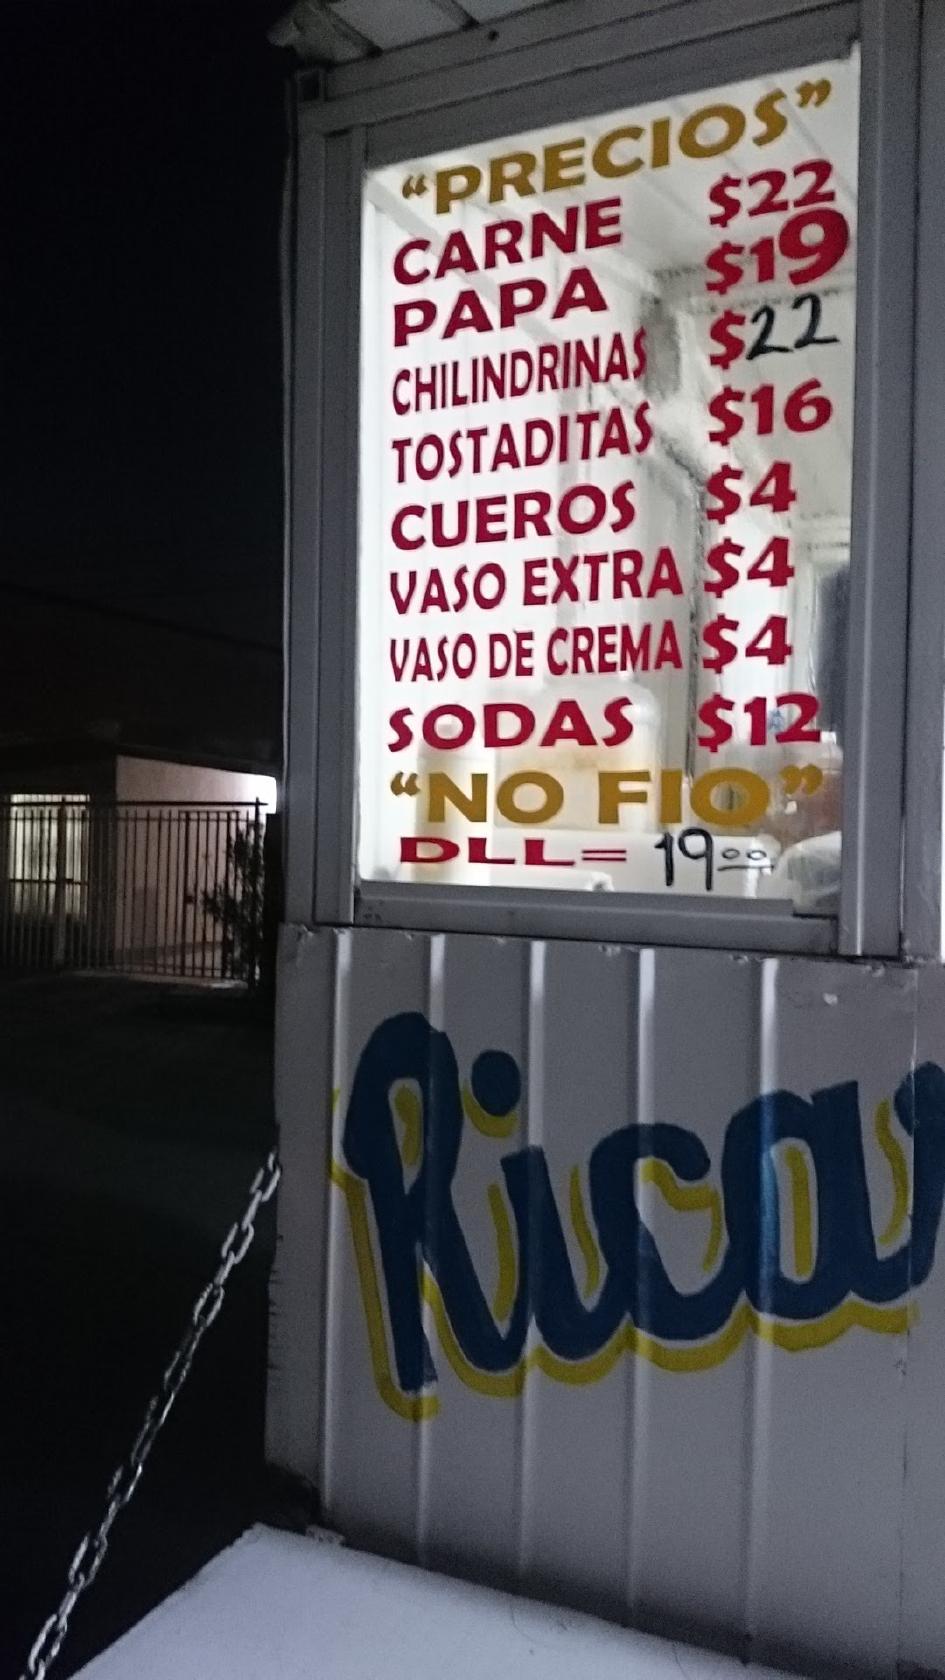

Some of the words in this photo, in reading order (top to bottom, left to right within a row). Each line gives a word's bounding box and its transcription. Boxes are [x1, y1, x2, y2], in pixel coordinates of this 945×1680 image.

[393, 198, 622, 286] CARNE
[709, 159, 835, 228] $22
[394, 267, 608, 347] PAPA
[705, 207, 849, 295] $19
[392, 327, 647, 416] CHILINDRINAS
[709, 293, 839, 370] $22
[391, 401, 653, 484] TOSTADITAS
[708, 378, 833, 446] $16
[391, 481, 635, 551] CUEROS
[705, 461, 797, 525] $4
[390, 561, 506, 615] VASO
[523, 547, 684, 606] EXTRA
[703, 537, 795, 599] $4
[390, 633, 477, 682] VASO
[488, 628, 534, 678] DE
[546, 619, 683, 676] CREMA
[702, 614, 793, 674] $4
[388, 697, 635, 753] SODAS
[697, 692, 822, 753] $12
